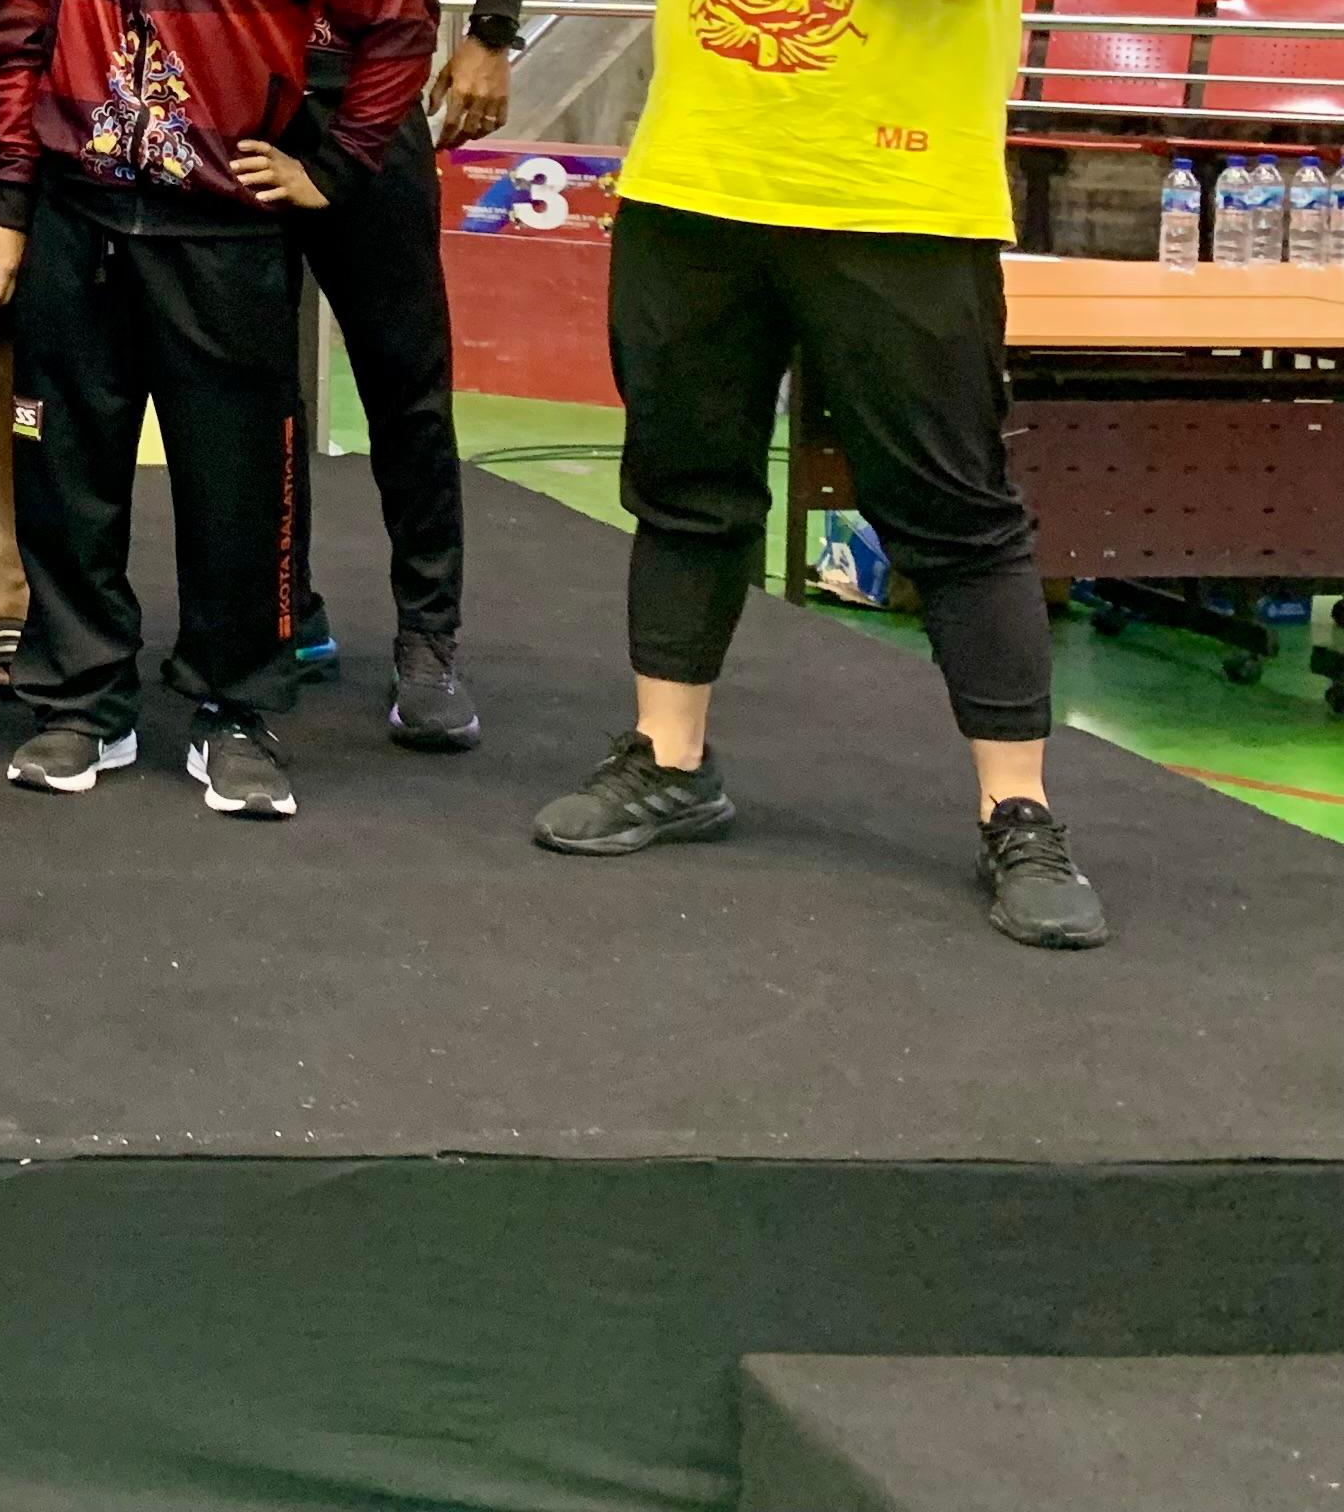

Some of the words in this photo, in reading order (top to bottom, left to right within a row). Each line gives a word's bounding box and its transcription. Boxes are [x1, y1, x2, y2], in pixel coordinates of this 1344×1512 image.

[876, 126, 929, 152] MB
[513, 157, 569, 230] 3
[279, 554, 292, 616] KOTA
